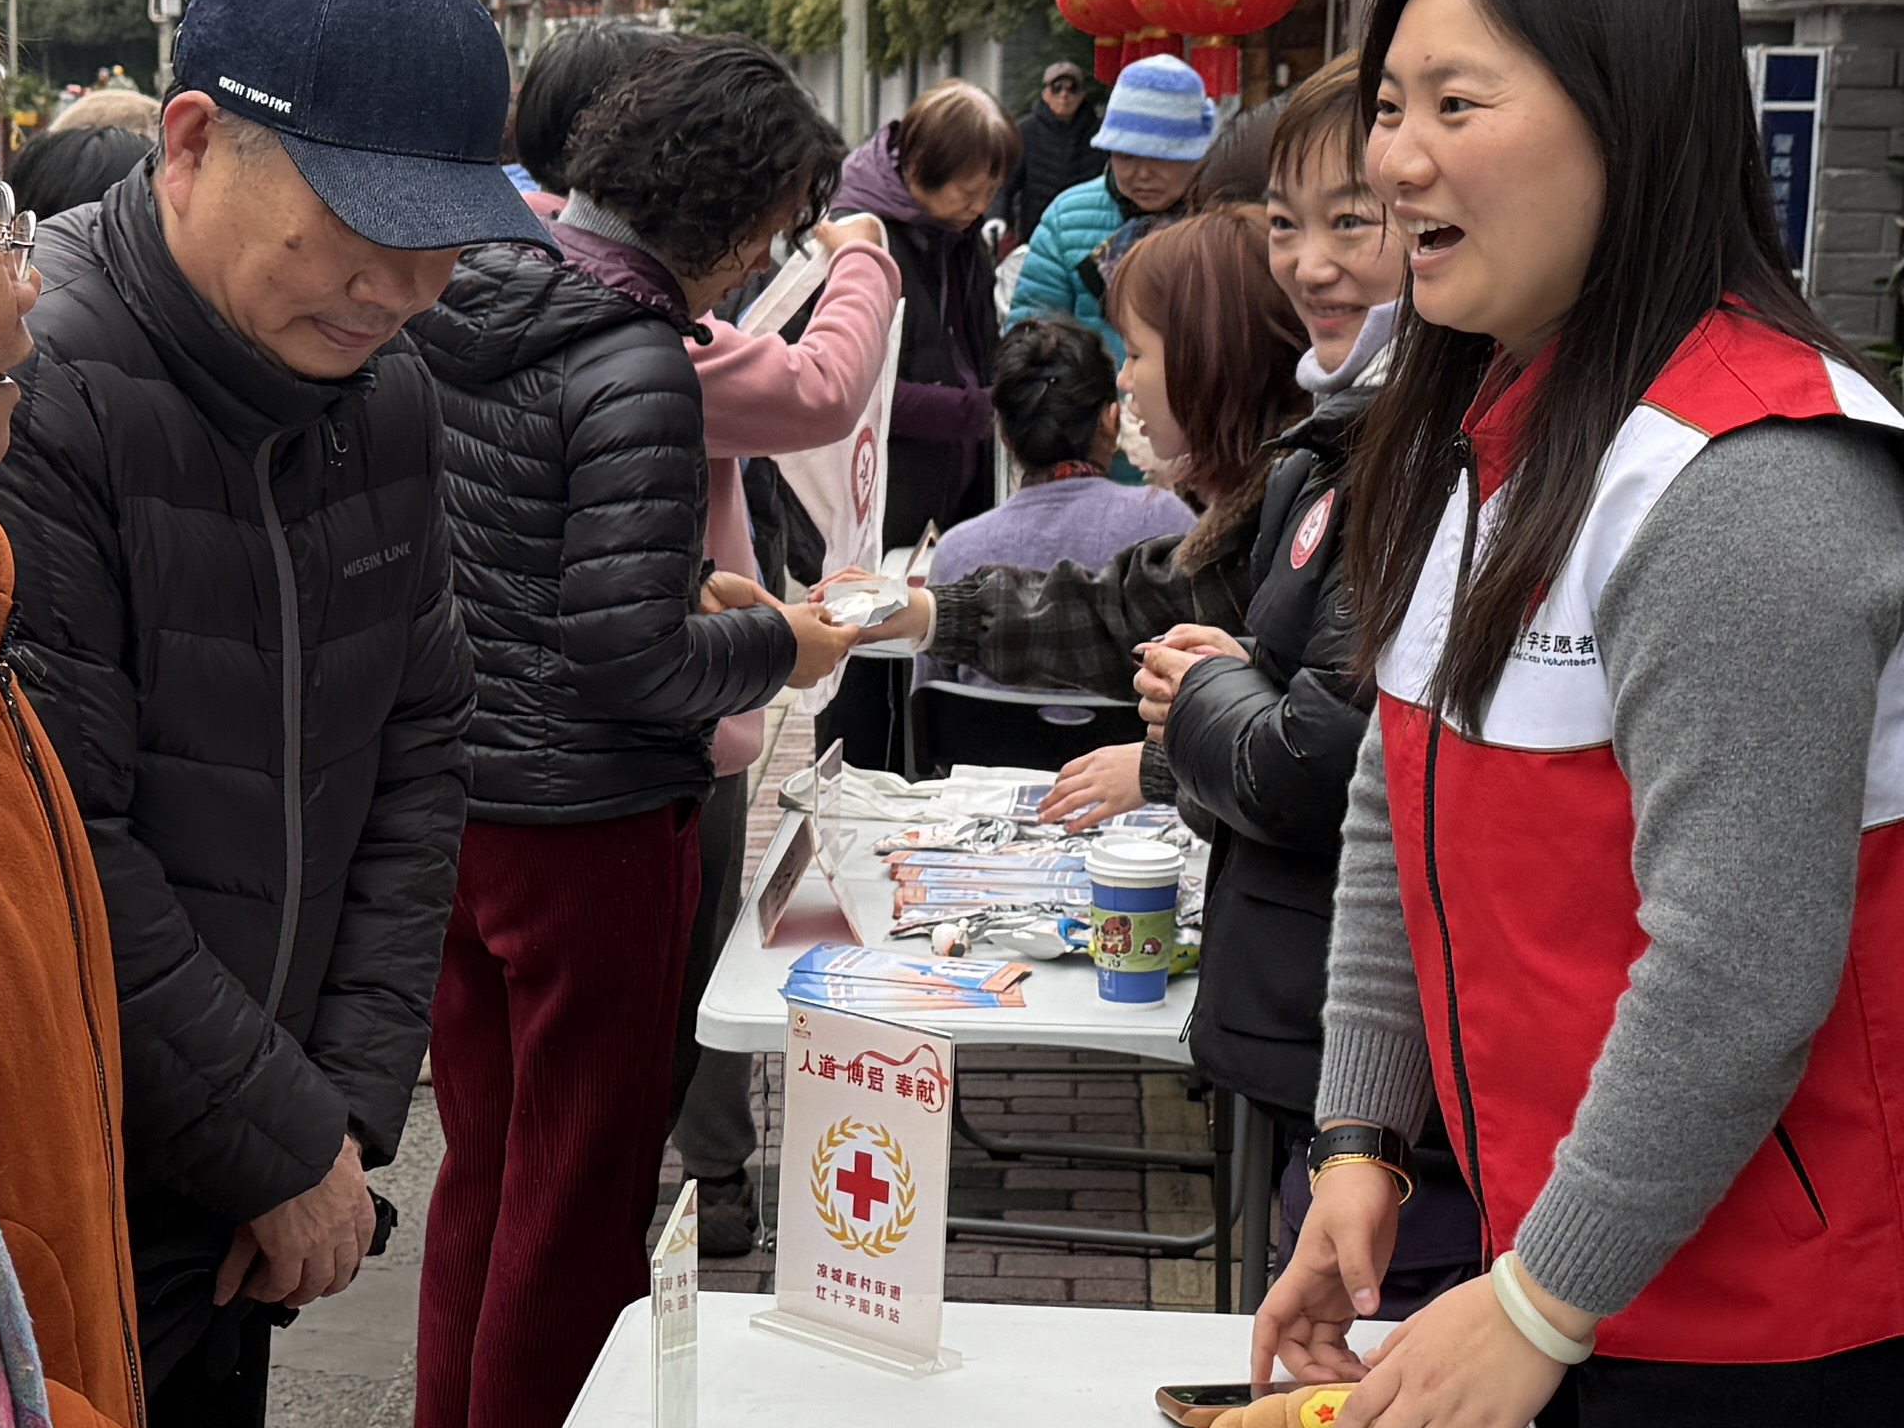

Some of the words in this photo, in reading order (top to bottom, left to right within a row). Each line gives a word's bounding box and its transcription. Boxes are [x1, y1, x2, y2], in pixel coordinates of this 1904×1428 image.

[246, 87, 269, 105] TWO
[798, 1049, 836, 1081] 人道
[846, 1059, 884, 1093] 博爱
[895, 1073, 936, 1105] 奉献
[816, 1284, 900, 1324] 红十字服务站
